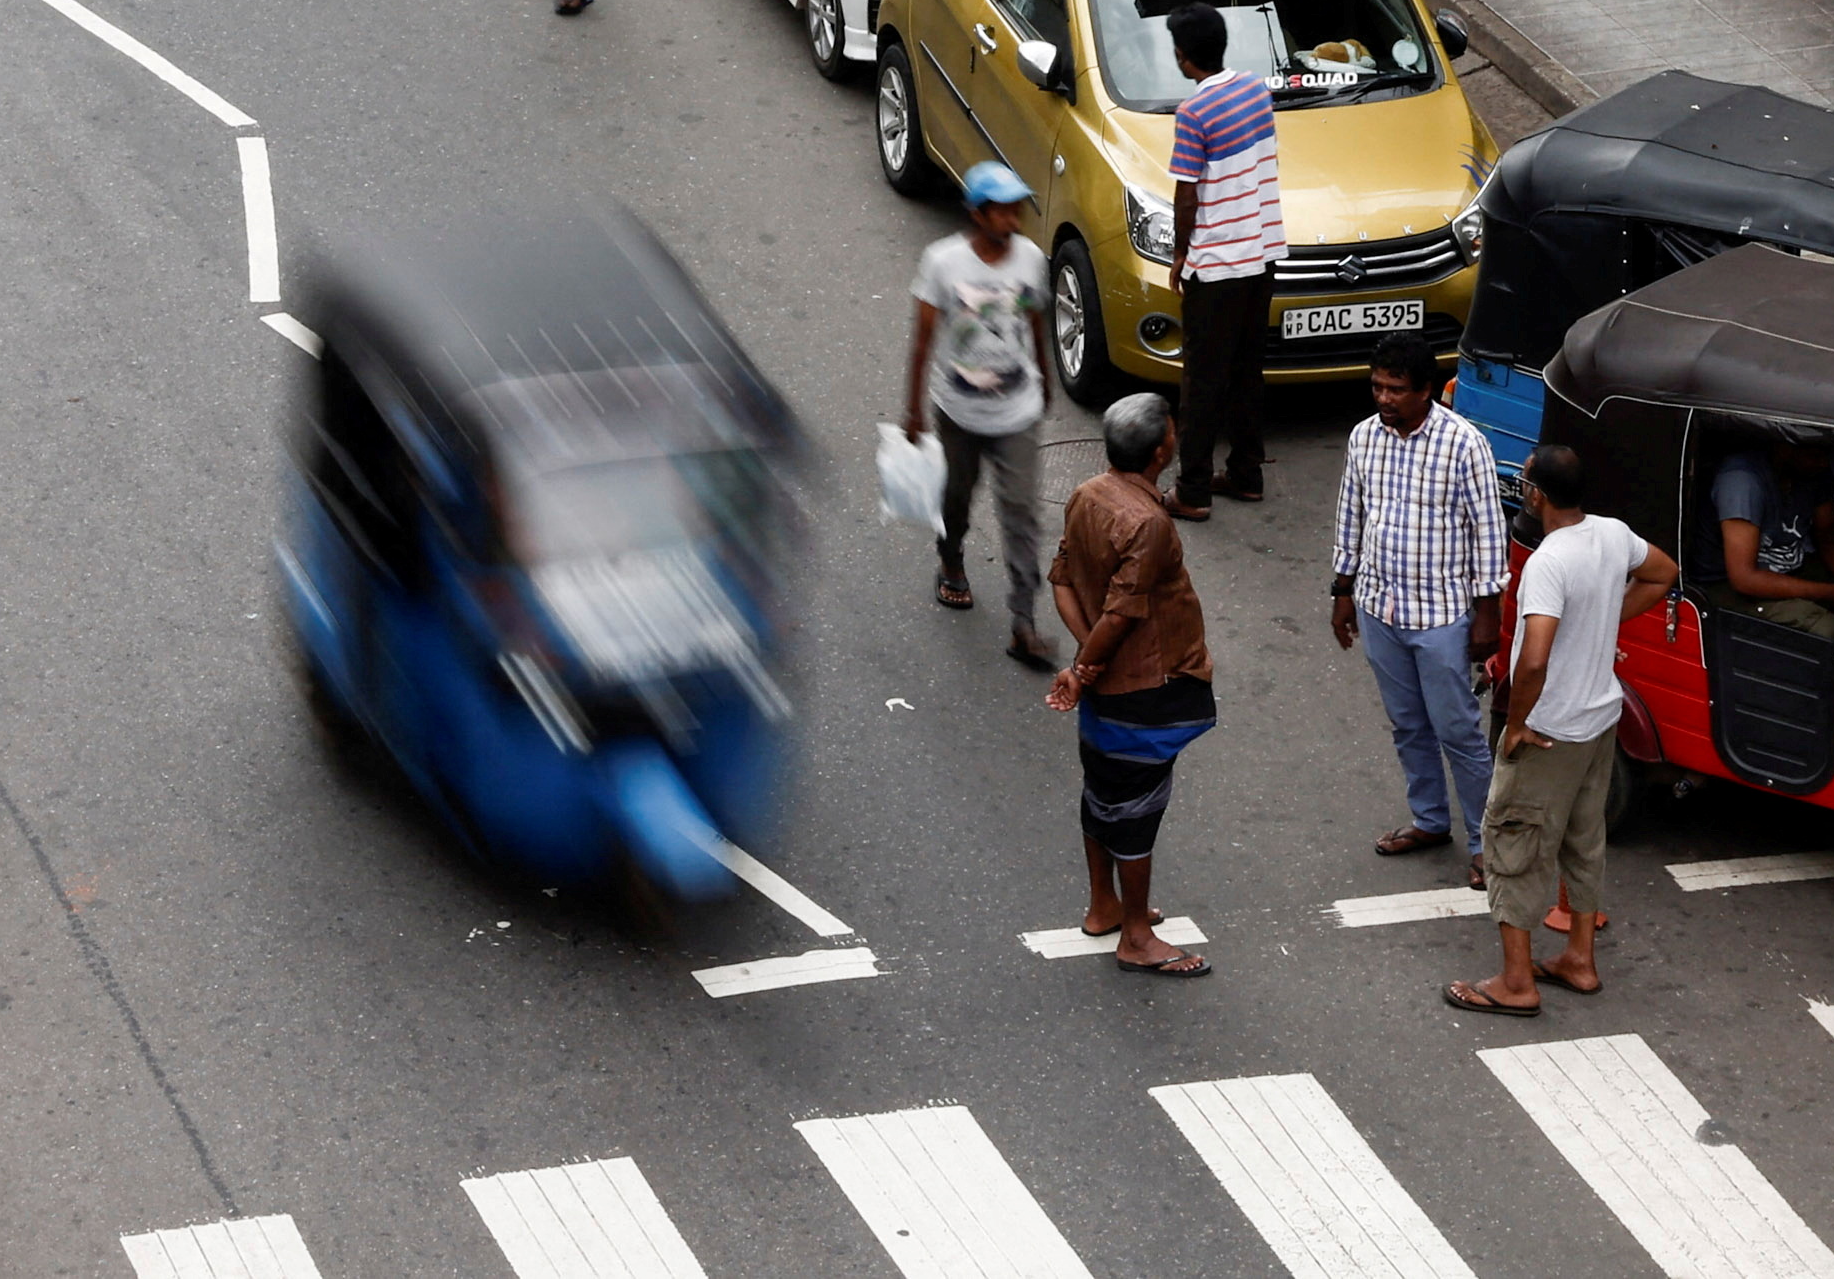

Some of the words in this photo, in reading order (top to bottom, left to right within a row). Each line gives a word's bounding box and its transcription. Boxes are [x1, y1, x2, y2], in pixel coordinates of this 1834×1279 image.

[1289, 72, 1359, 88] SQUAD
[1308, 308, 1352, 333] CAC
[1362, 304, 1420, 330] 5395
